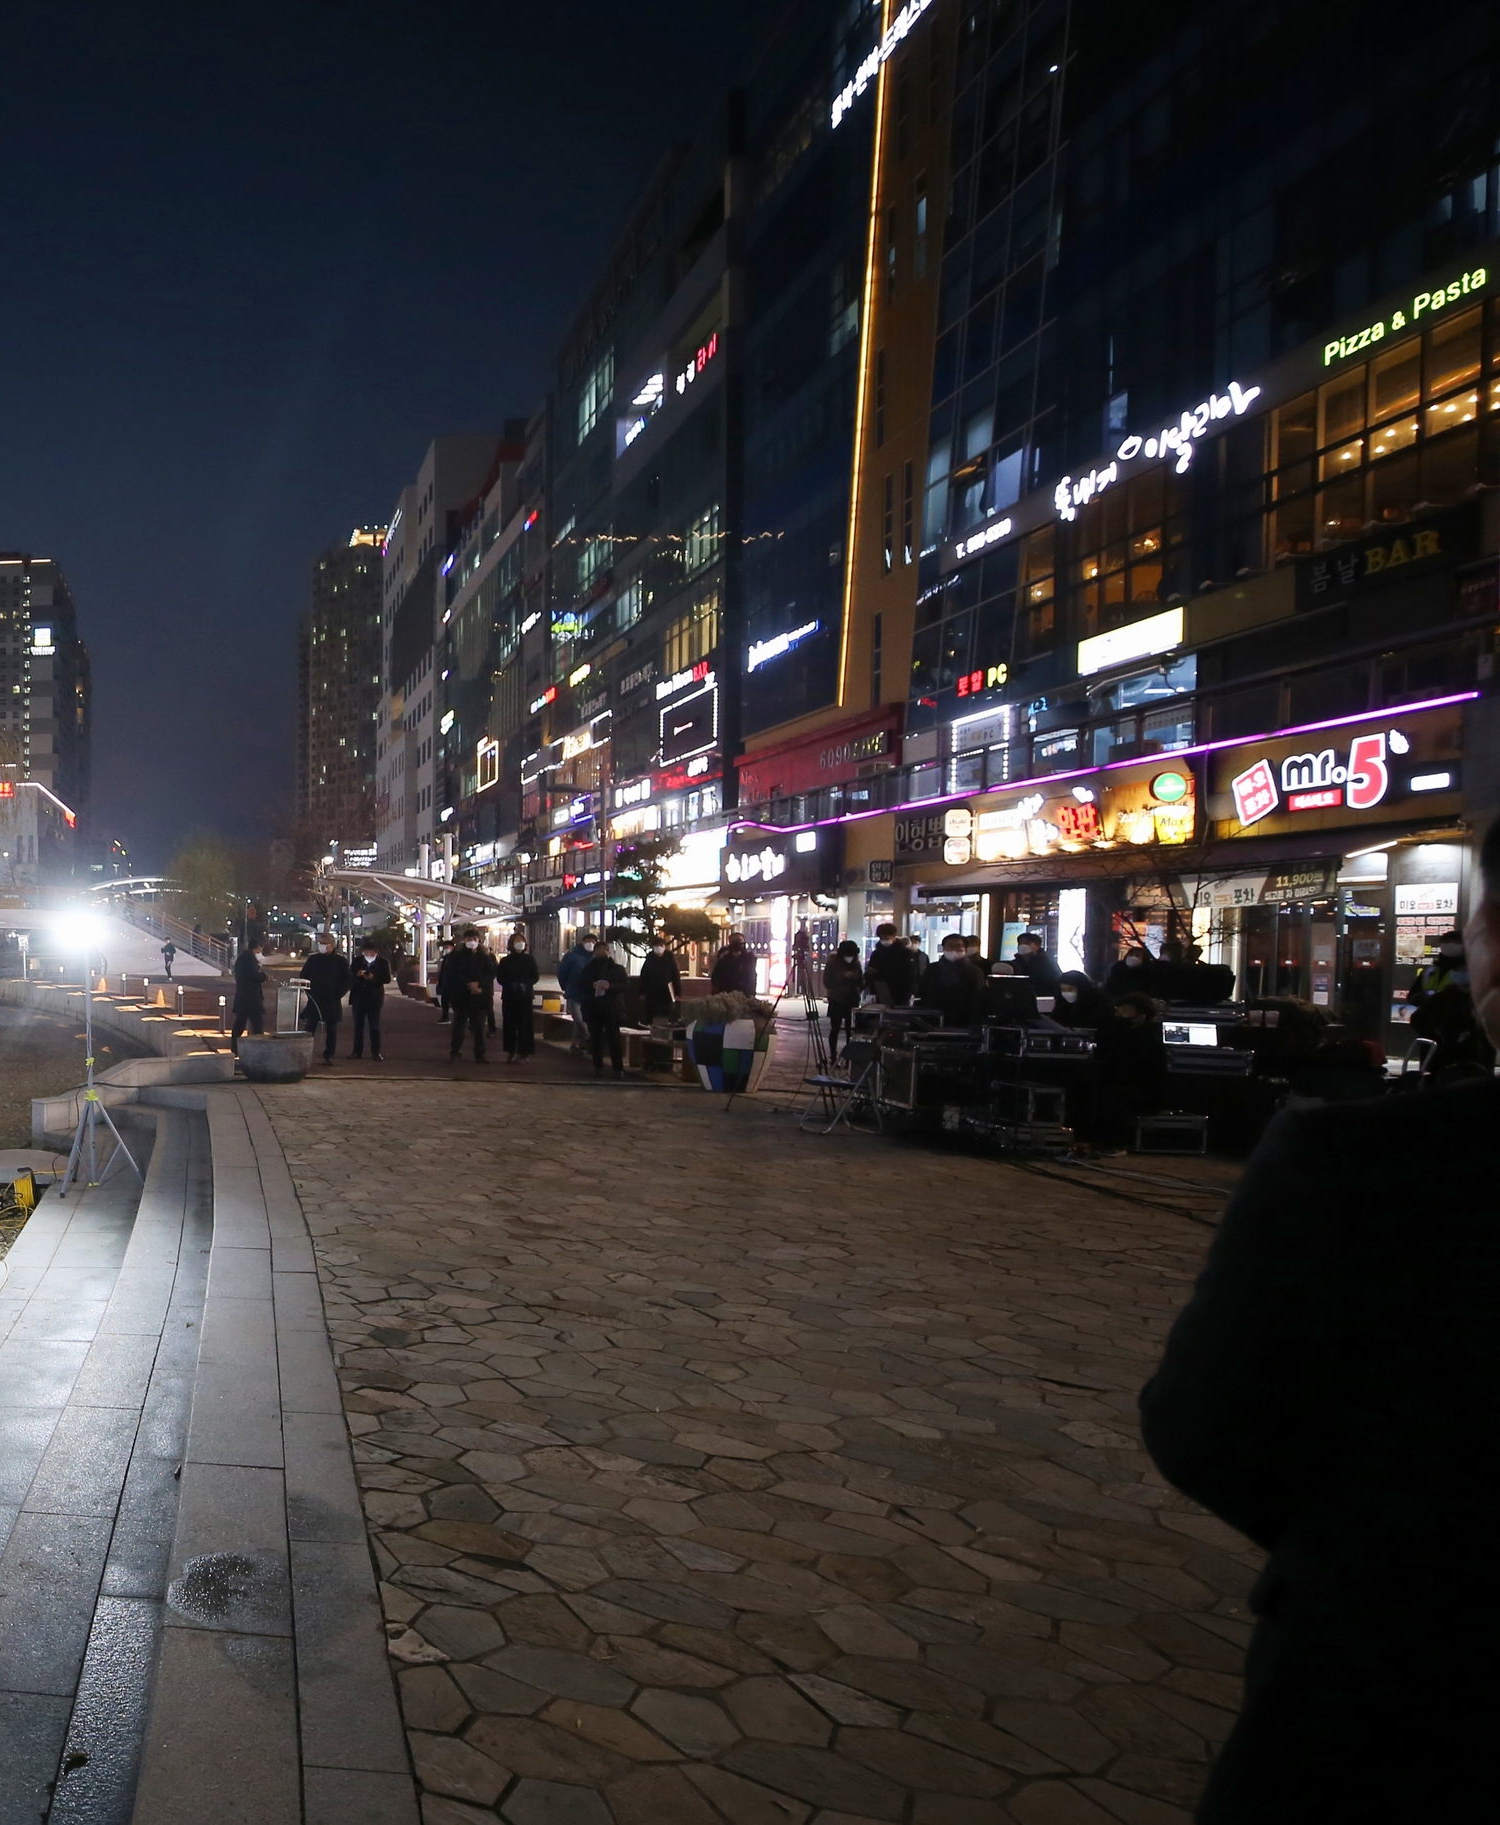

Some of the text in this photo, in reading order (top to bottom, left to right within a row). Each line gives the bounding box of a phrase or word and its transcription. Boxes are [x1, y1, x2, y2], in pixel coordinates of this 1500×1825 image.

[1324, 268, 1487, 366] Pizza & Pasta
[1310, 530, 1442, 594] 봄날 BAR
[693, 661, 708, 681] BAR
[987, 663, 1008, 688] PC
[895, 817, 946, 853] 인형뽑
[1056, 802, 1099, 839] 한판
[1399, 899, 1454, 910] 미오 포차
